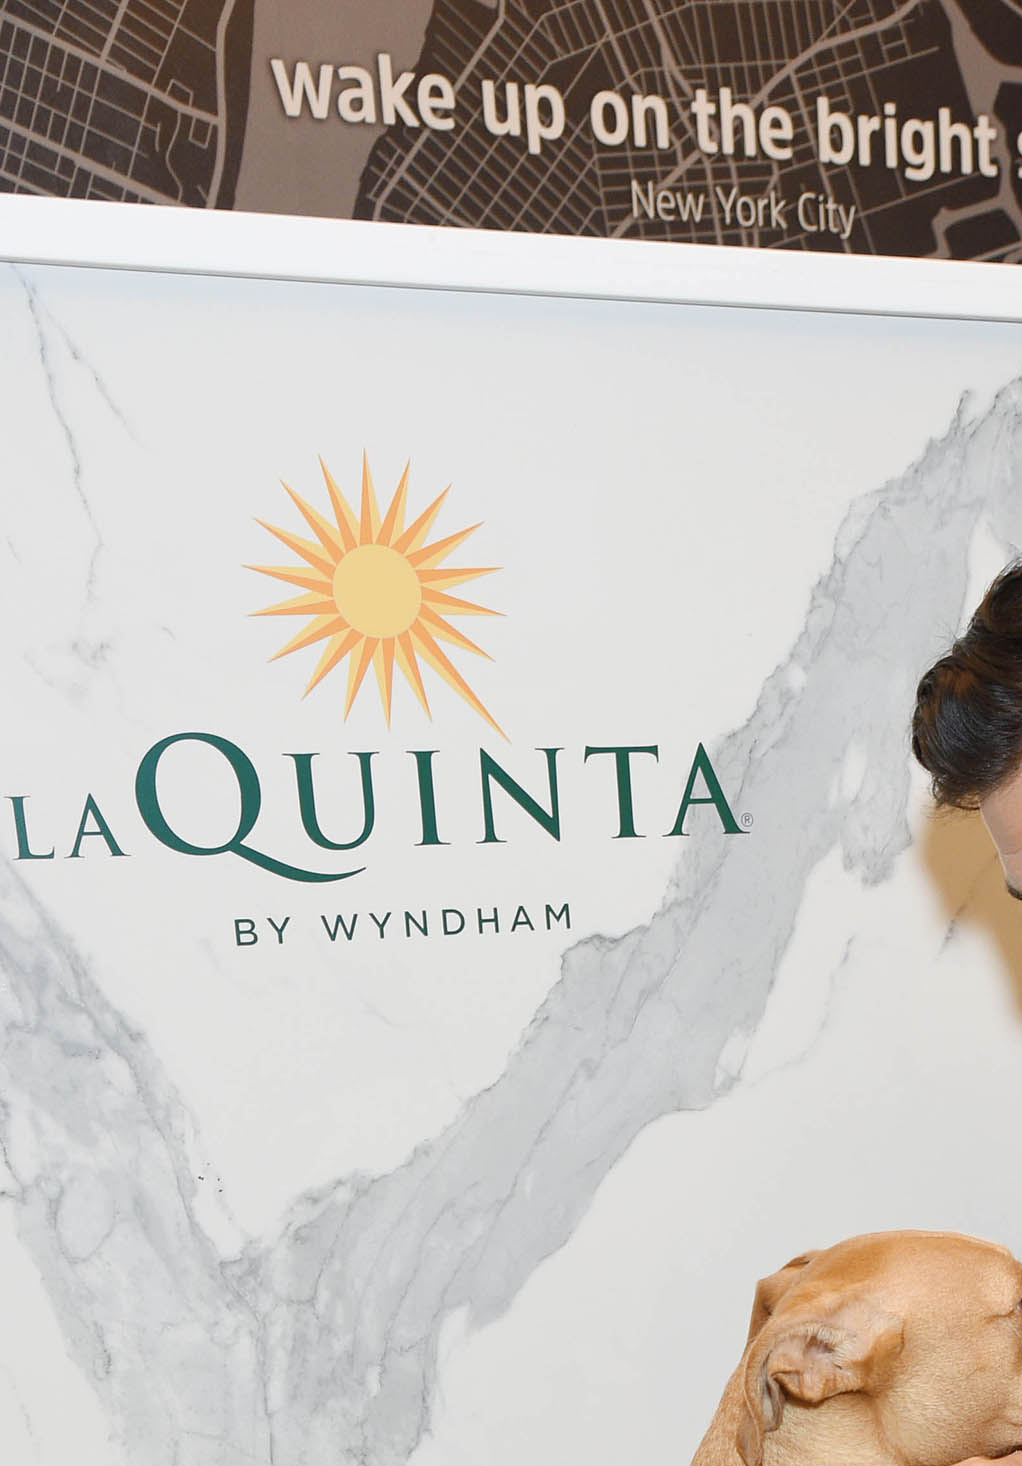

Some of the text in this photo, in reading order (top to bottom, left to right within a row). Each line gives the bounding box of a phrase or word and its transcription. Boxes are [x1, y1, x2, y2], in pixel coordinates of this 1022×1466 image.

[270, 53, 455, 130] wake
[481, 79, 566, 155] up
[590, 90, 670, 150] on
[691, 87, 793, 161] the
[816, 96, 998, 181] bright
[630, 180, 856, 239] New York City
[4, 732, 750, 883] LA QUINTA
[235, 903, 572, 947] BY WYNDHAM
